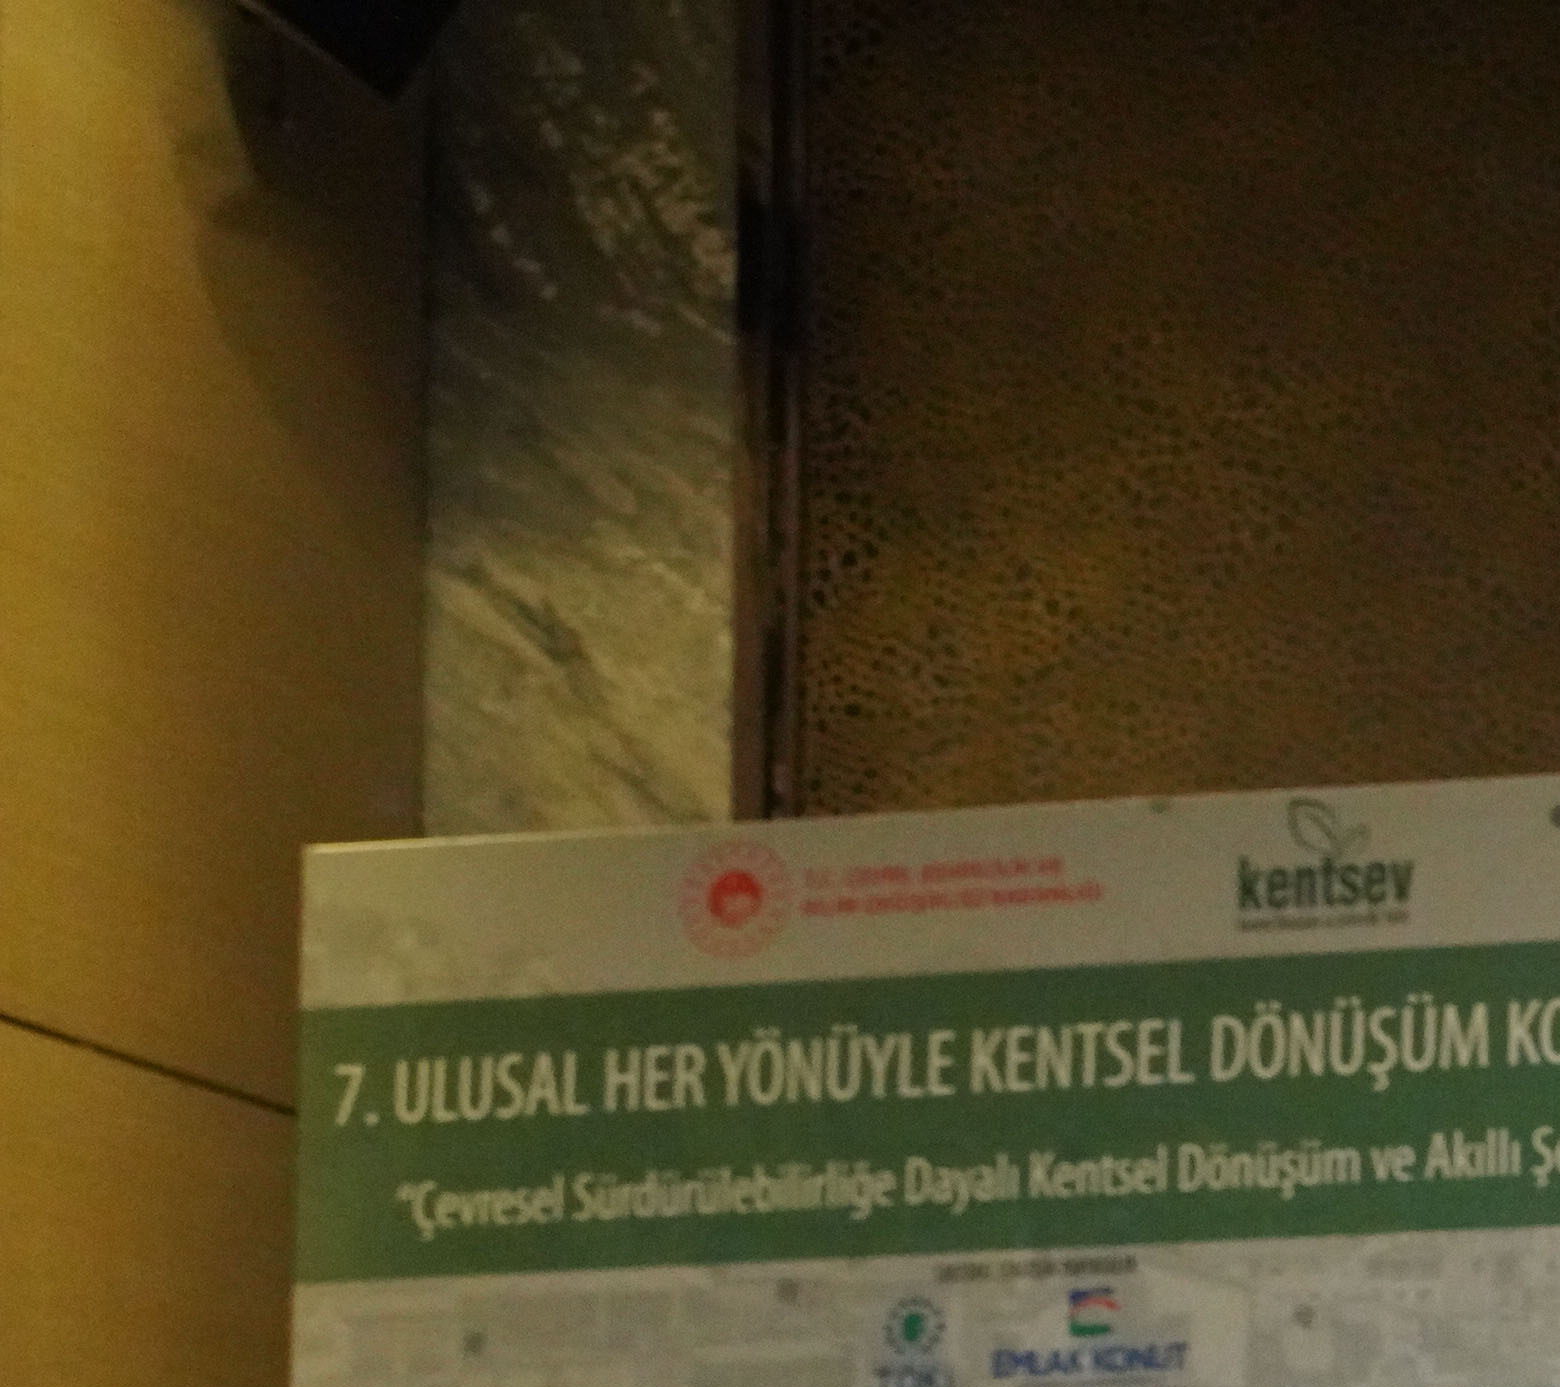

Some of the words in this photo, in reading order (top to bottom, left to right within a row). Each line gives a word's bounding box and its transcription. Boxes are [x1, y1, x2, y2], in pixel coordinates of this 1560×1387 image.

[1236, 853, 1415, 911] kentsev
[333, 1064, 378, 1128] 7.
[395, 1051, 589, 1126] ULUSAL
[604, 1044, 707, 1114] HER
[717, 1025, 956, 1108] YÖNÜYLE
[970, 1018, 1195, 1094] KENTSEL
[1211, 992, 1491, 1092] DÖNÜŞÜM
[572, 1158, 897, 1225] Sürdürülebilirliğe
[905, 1152, 1021, 1215] Dayalı
[1028, 1143, 1168, 1198] Kentsel
[1177, 1132, 1361, 1200] Dönüşüm
[1372, 1146, 1415, 1182] ve
[1424, 1126, 1522, 1182] Akıllı
